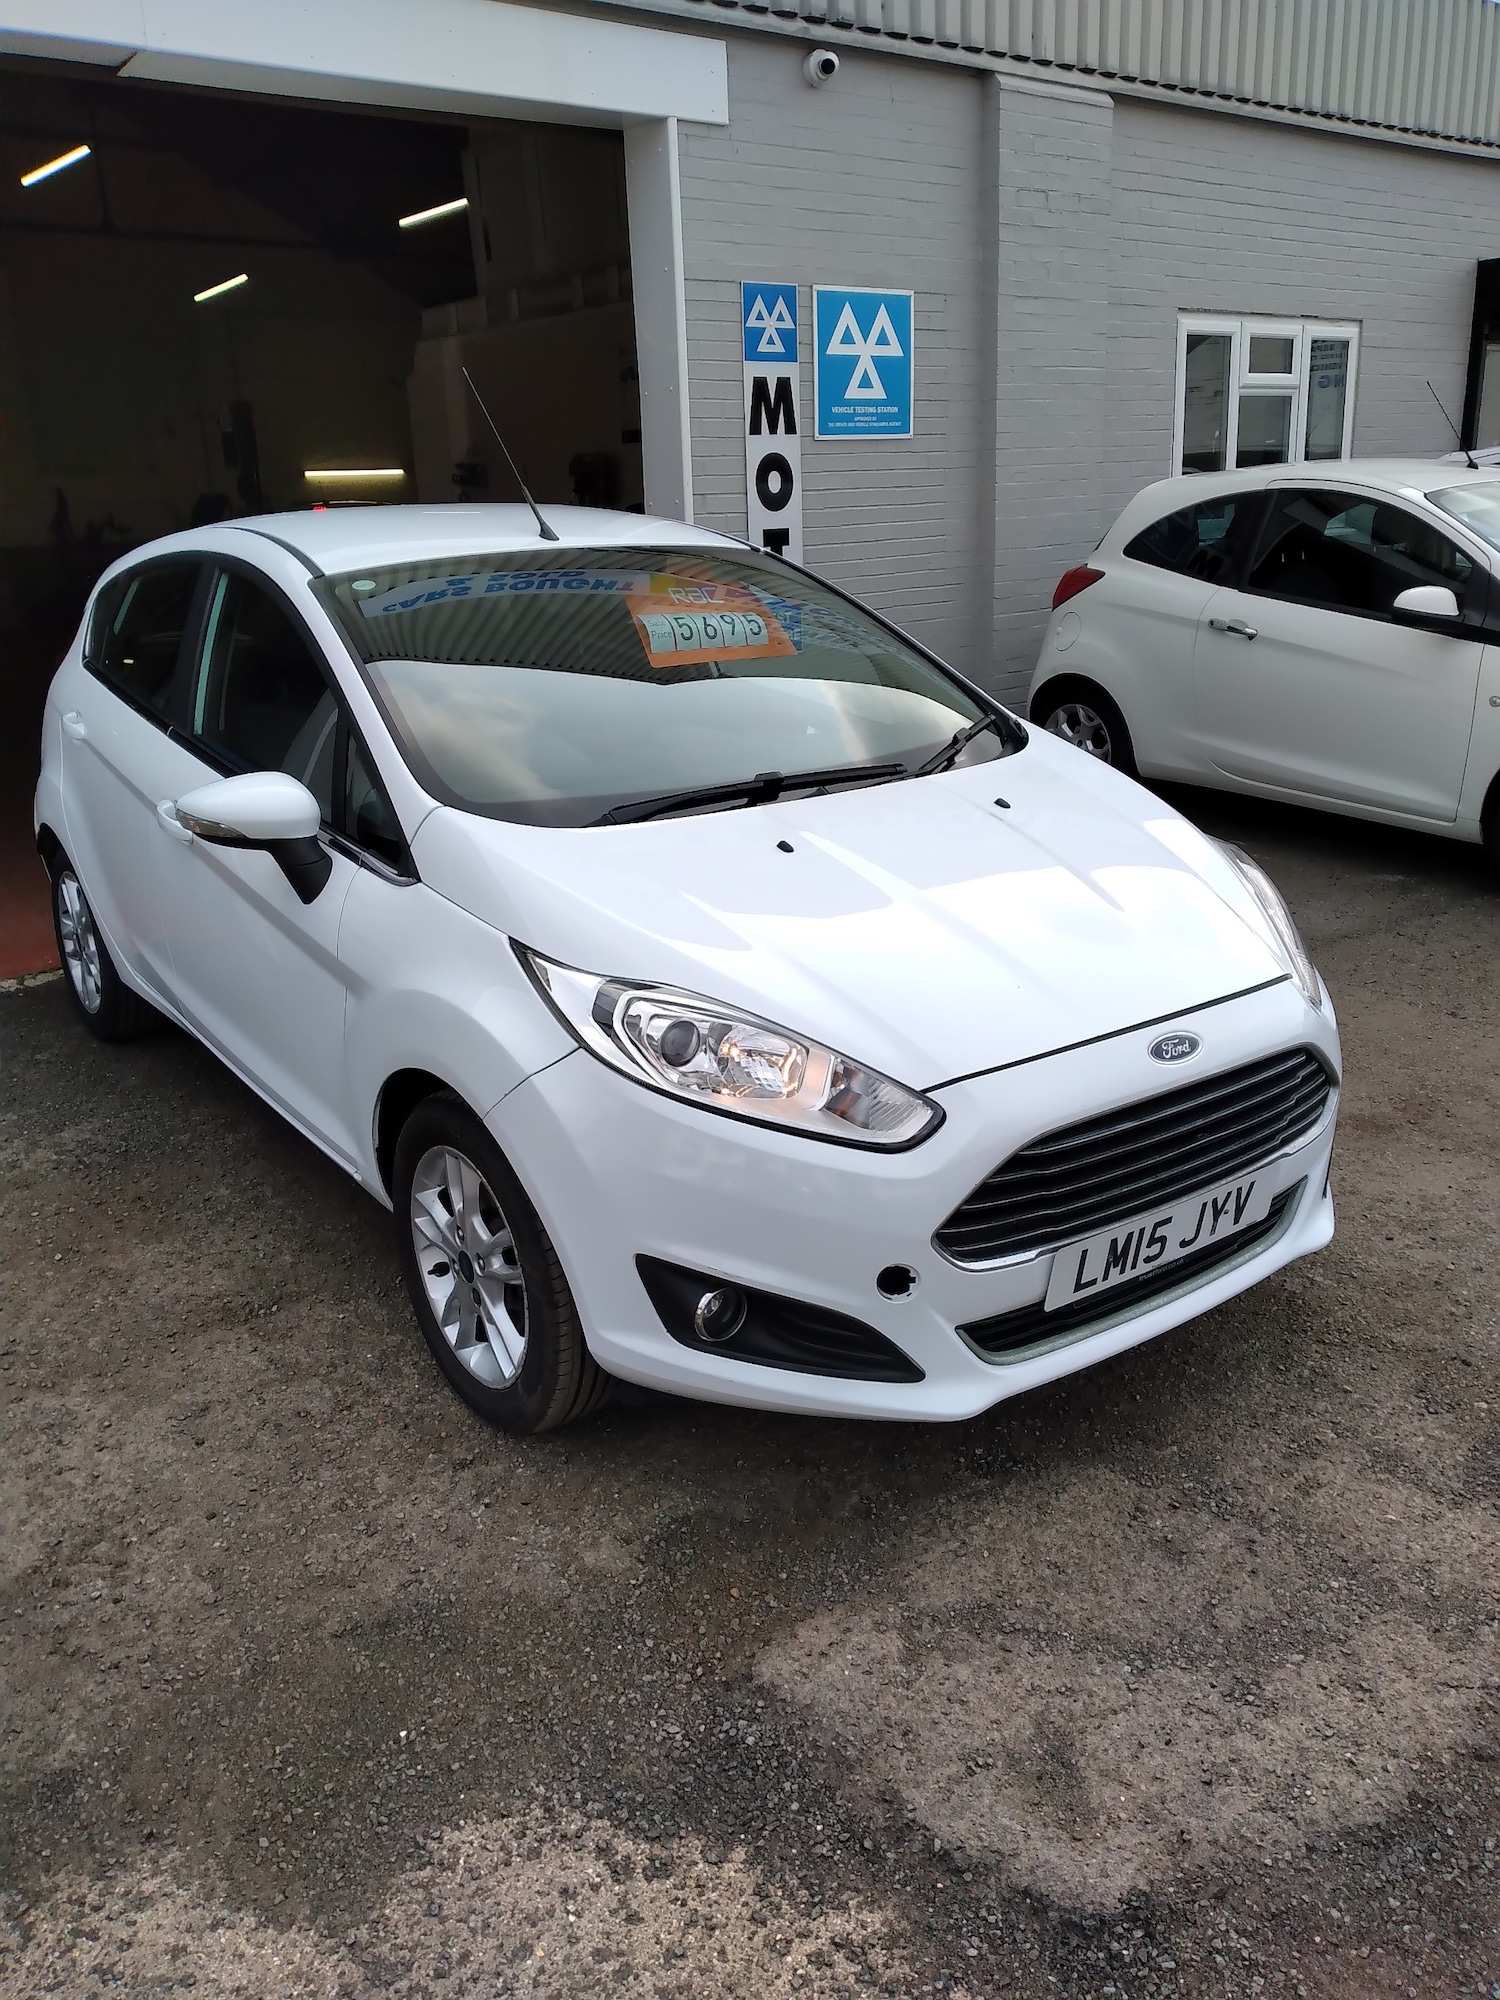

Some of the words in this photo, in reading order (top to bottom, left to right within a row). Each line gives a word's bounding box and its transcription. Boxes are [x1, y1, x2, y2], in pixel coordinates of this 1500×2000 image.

[651, 630, 673, 639] Price
[1161, 1038, 1192, 1059] Ford
[1073, 1216, 1174, 1294] LM15
[1179, 1180, 1257, 1249] JYV
